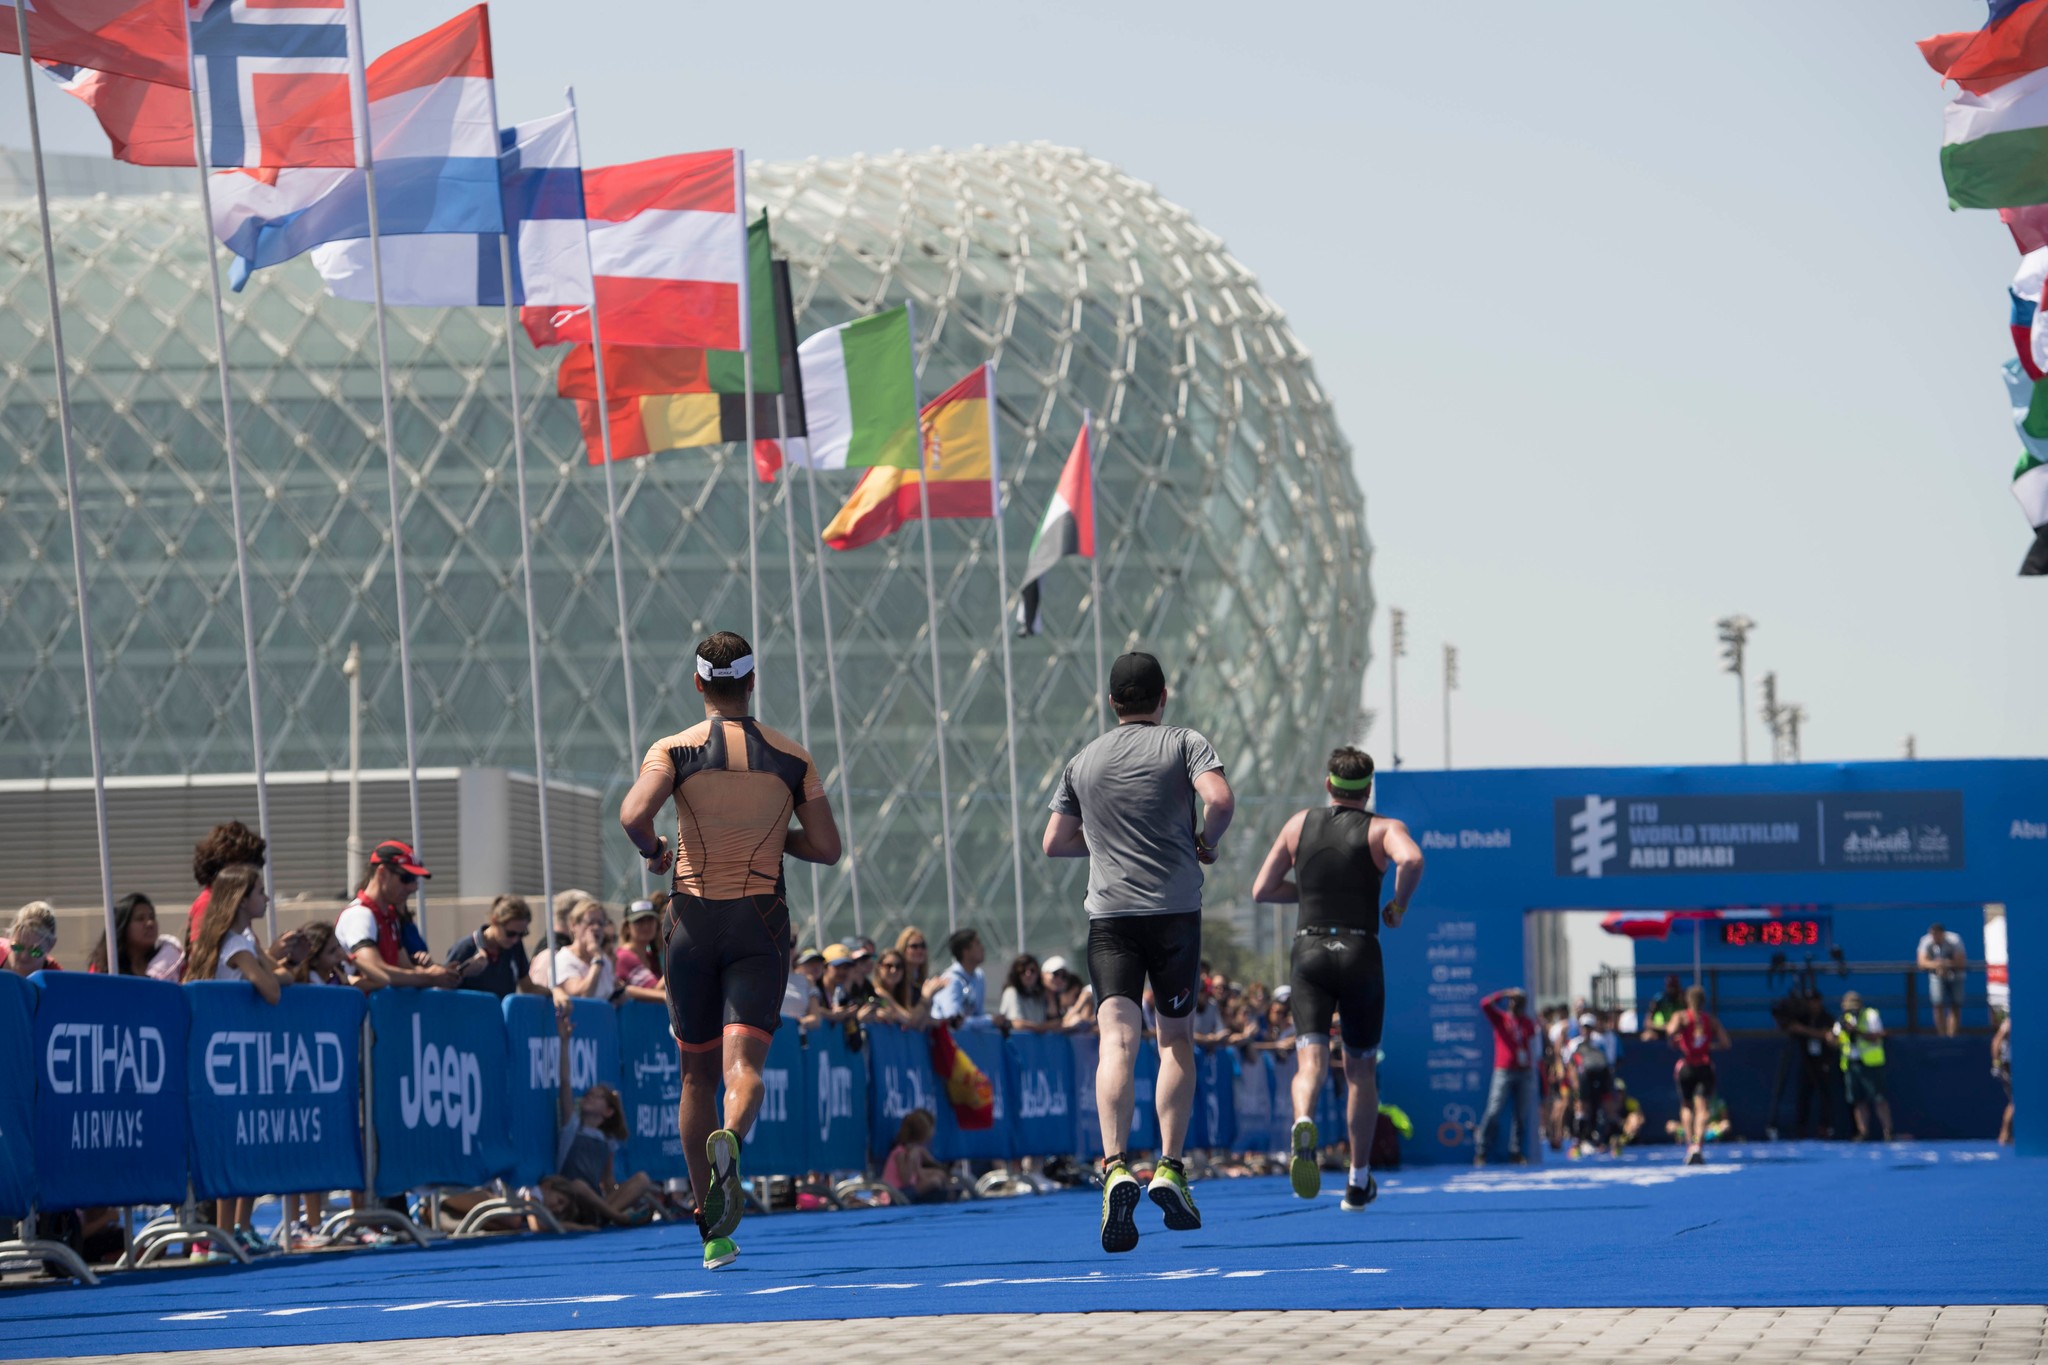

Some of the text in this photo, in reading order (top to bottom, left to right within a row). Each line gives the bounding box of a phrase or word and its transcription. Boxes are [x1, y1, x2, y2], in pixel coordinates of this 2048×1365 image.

[1628, 803, 1658, 824] ITU
[2010, 819, 2047, 839] Abu
[1422, 828, 1511, 848] Abu Dhabi
[1629, 822, 1799, 845] WORLD TRIATHLON
[1629, 846, 1735, 868] ABU DHABI
[47, 1023, 166, 1094] ETIHAD
[205, 1031, 344, 1095] ETIHAD
[528, 1036, 598, 1090] TRIATLON
[400, 1012, 482, 1155] Jeep
[71, 1109, 143, 1149] AIRWAYS
[236, 1107, 321, 1146] AIRWAYS
